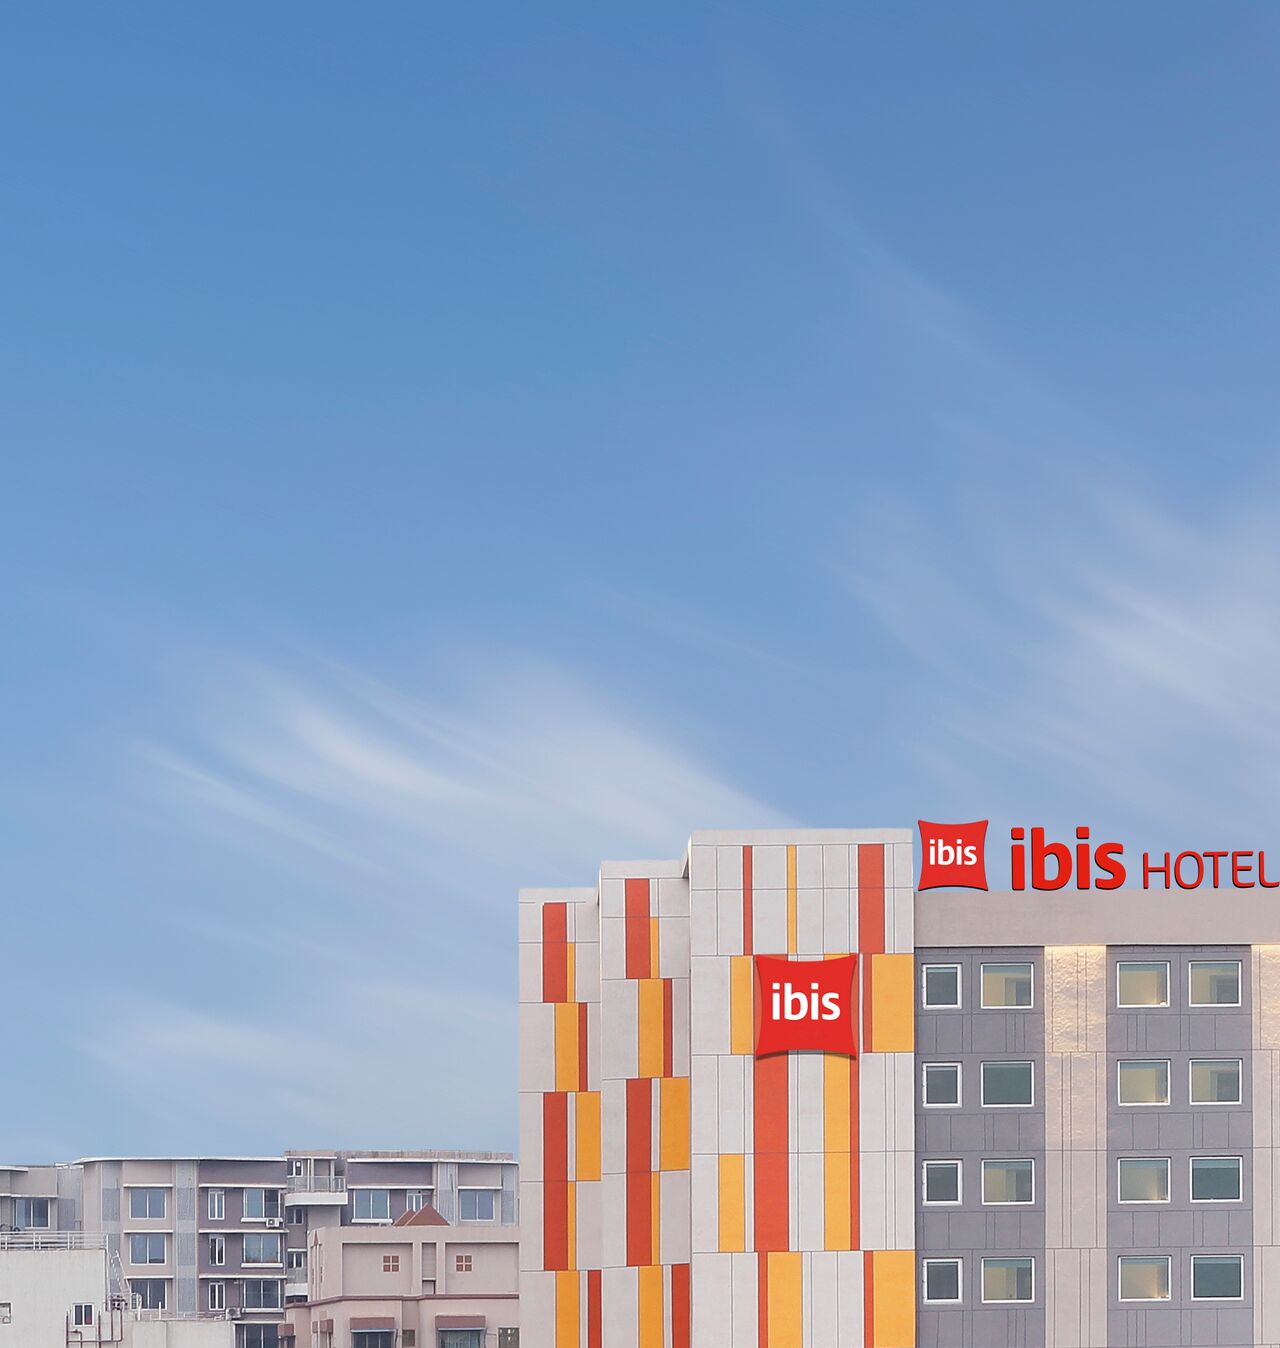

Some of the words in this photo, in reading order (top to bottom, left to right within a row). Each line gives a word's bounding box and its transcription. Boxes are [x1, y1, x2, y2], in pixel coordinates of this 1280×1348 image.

[930, 839, 978, 866] ibis
[1011, 826, 1126, 890] ibis
[1142, 850, 1280, 889] HOTEL
[772, 982, 841, 1021] ibis
